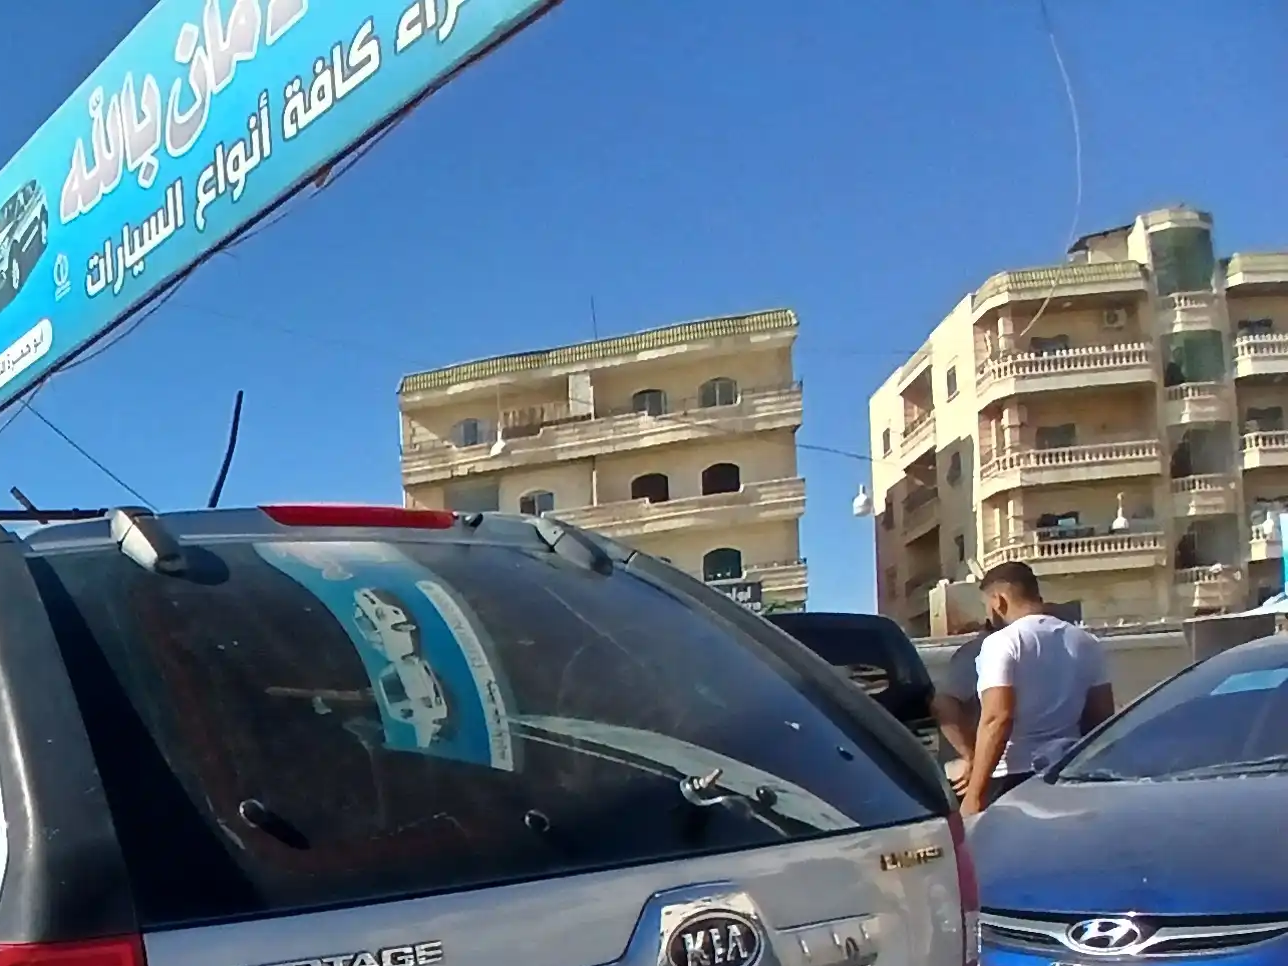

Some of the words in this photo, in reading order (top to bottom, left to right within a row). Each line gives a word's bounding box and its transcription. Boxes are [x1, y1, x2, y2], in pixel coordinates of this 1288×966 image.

[281, 15, 382, 141] كافة
[59, 71, 161, 225] بالله
[195, 88, 273, 232] أنواع
[85, 176, 186, 298] السيارات
